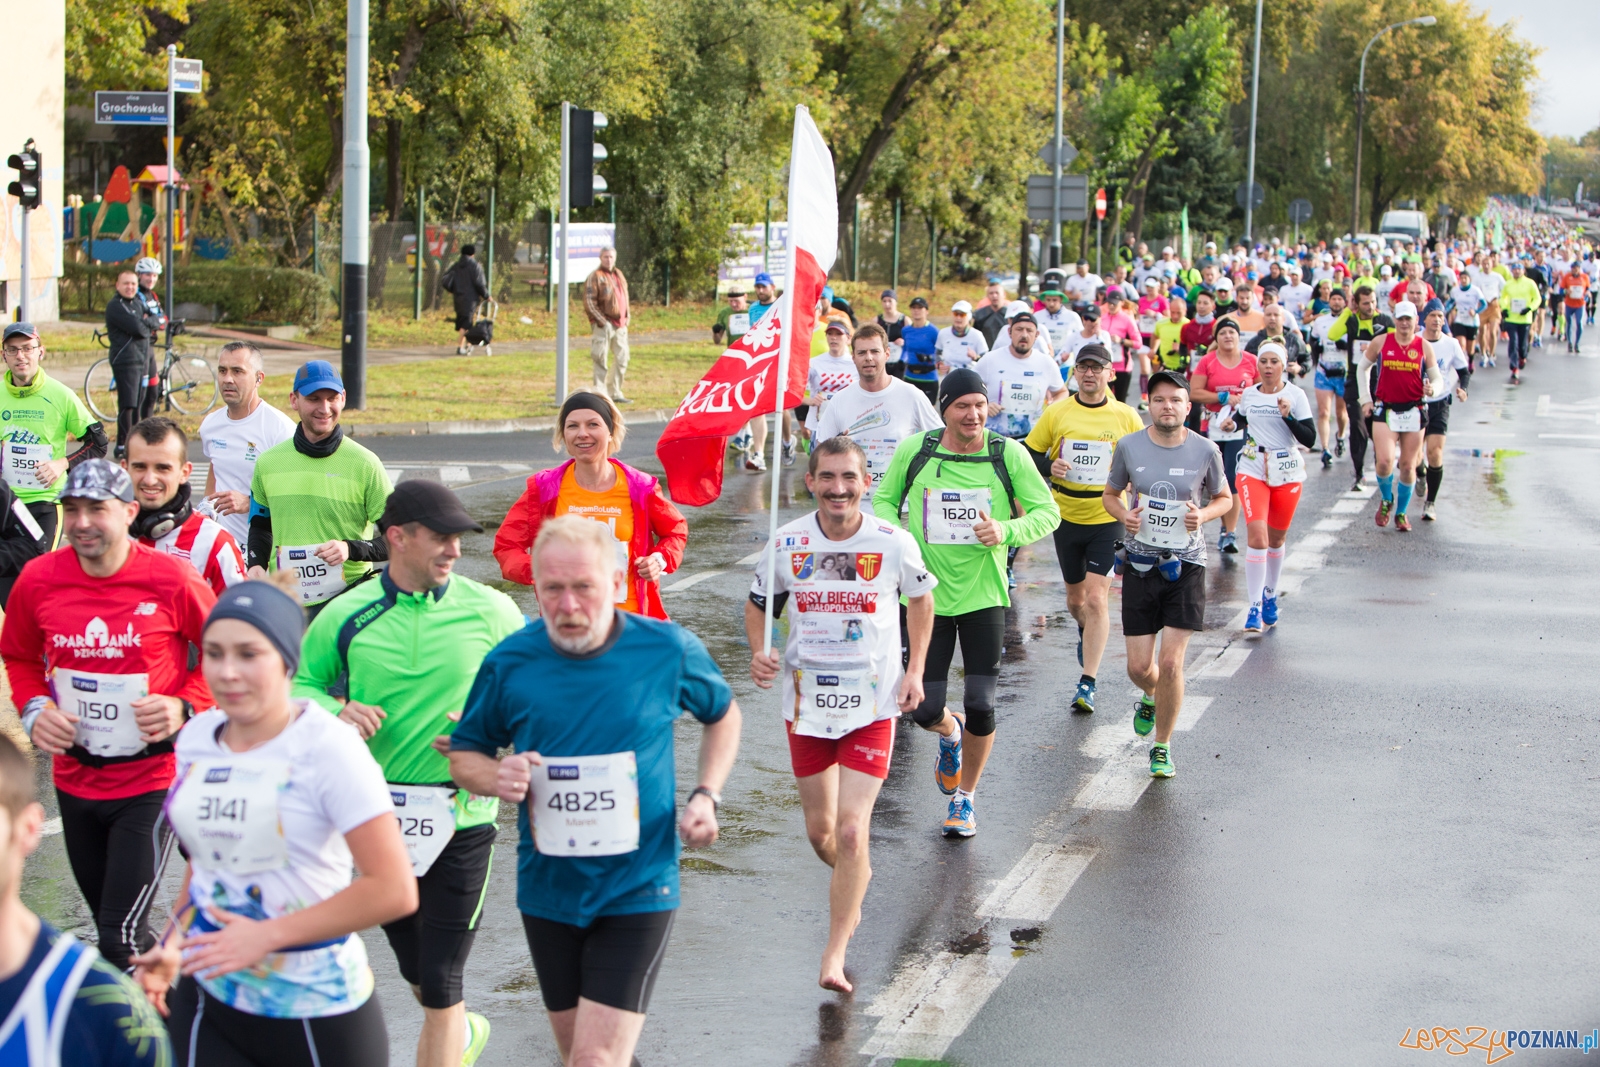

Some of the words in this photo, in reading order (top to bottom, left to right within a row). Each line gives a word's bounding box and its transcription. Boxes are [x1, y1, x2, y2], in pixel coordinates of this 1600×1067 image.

[101, 102, 165, 114] Grochowska
[1011, 392, 1032, 401] 4681
[1073, 455, 1101, 465] 4817
[1278, 459, 1298, 471] 2061
[1242, 485, 1253, 518] POLSKA
[942, 507, 977, 520] 1620
[1148, 513, 1178, 527] 5197
[301, 579, 321, 587] Daniel
[794, 591, 824, 604] BOSY
[806, 603, 862, 613] MAŁOPOLSKA
[353, 603, 385, 629] Joma
[816, 693, 861, 709] 6029
[77, 699, 119, 721] 1150
[547, 790, 616, 812] 4825
[197, 796, 247, 821] 3141
